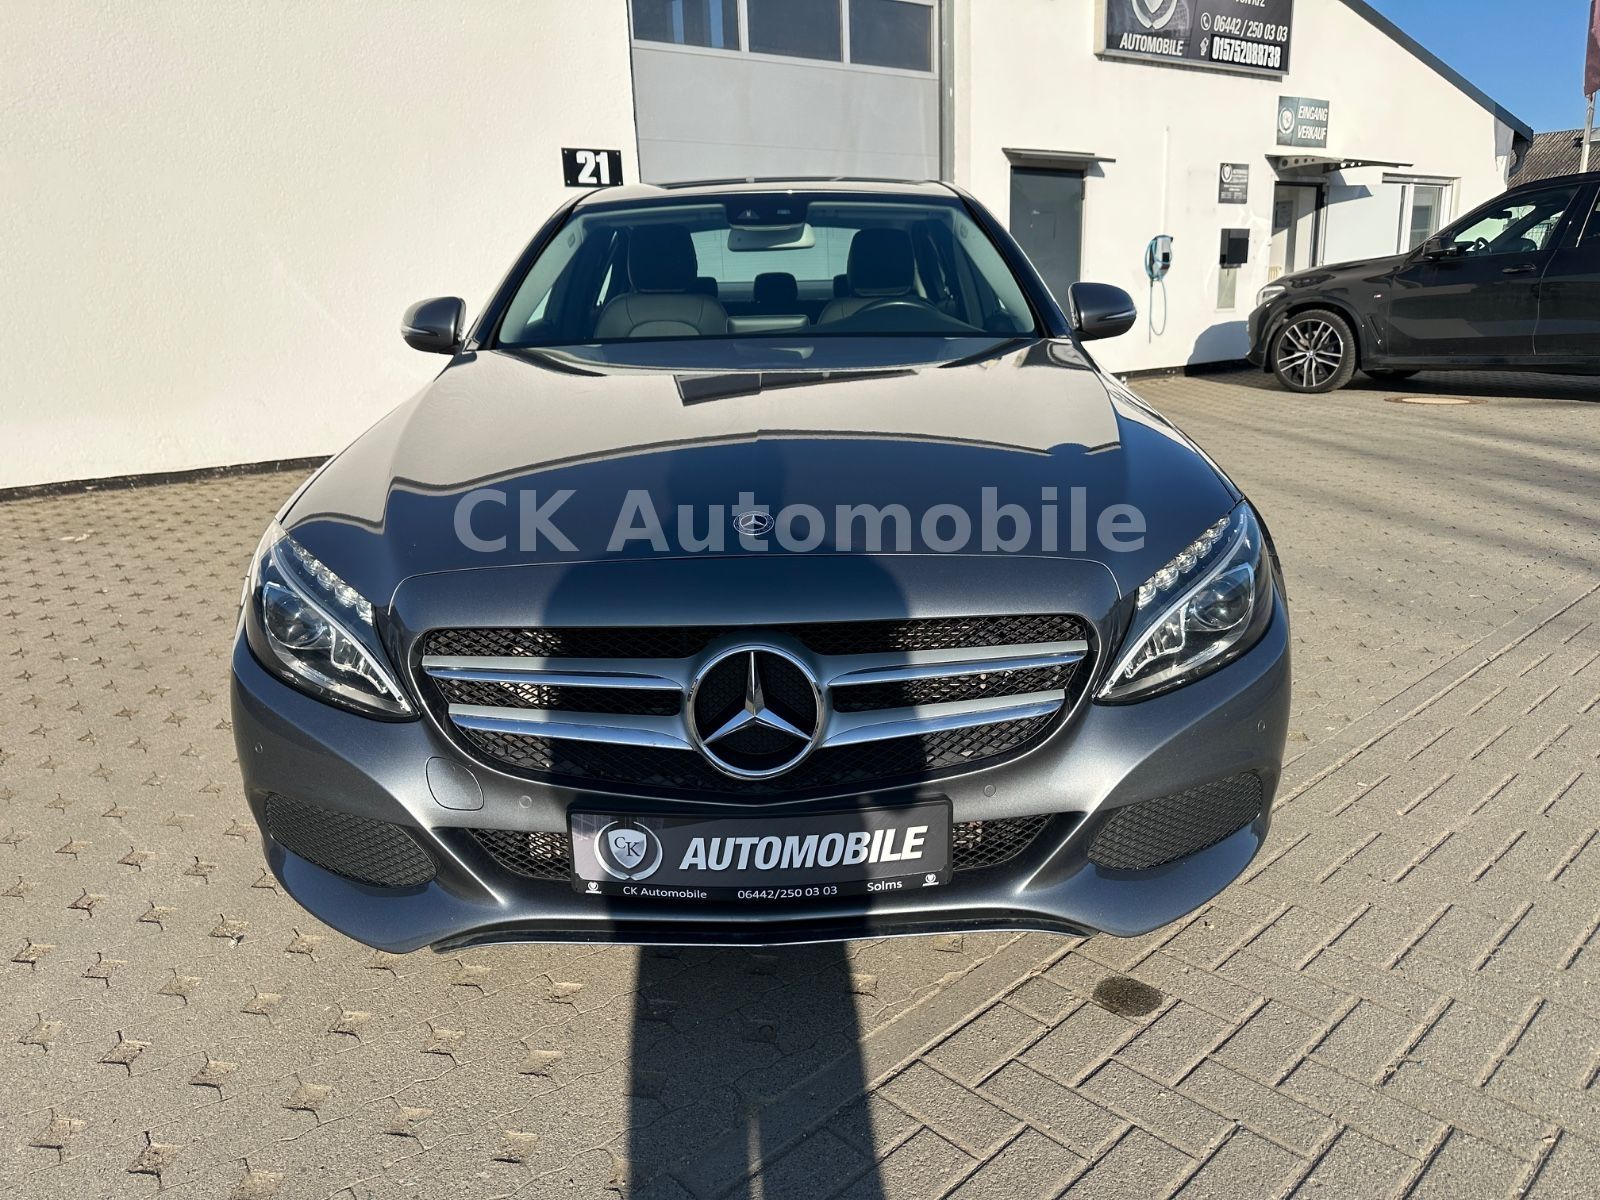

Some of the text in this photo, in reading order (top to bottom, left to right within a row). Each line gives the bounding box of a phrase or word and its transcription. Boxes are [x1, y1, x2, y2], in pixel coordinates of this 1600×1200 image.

[1213, 14, 1241, 35] 06442
[1247, 20, 1264, 38] 250
[1263, 23, 1276, 40] 03
[1276, 25, 1288, 42] 03
[1119, 32, 1185, 56] AUTOMOBILE
[1298, 105, 1328, 121] EINGANG
[1297, 125, 1327, 140] VERKAUF
[576, 150, 610, 184] 21
[614, 836, 640, 857] CK
[679, 825, 928, 871] AUTOMOBILE
[623, 886, 708, 899] CK Automobile
[737, 886, 838, 899] 06442/250 03 03
[866, 879, 903, 892] Solms
